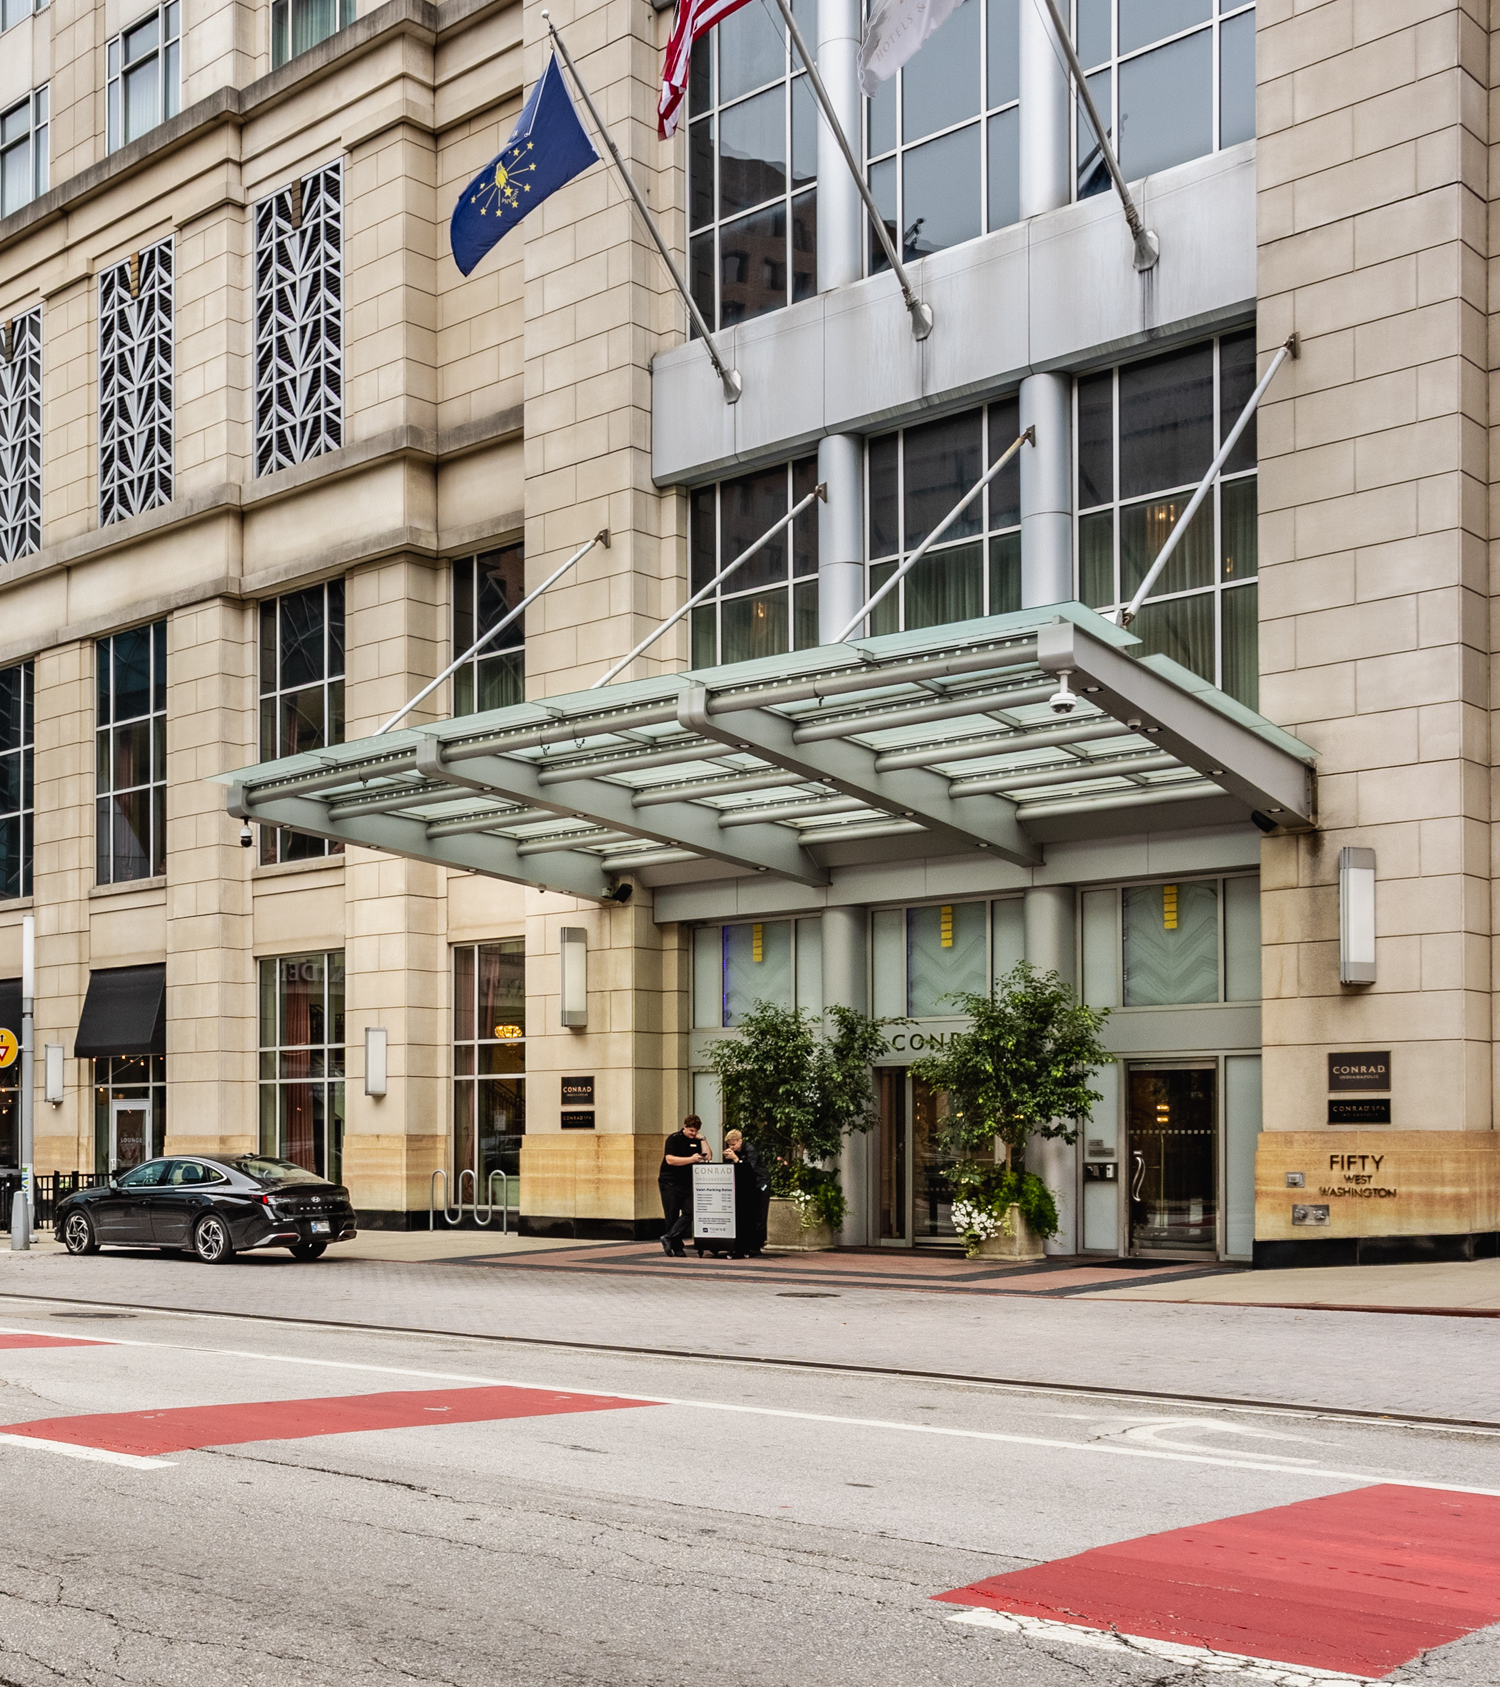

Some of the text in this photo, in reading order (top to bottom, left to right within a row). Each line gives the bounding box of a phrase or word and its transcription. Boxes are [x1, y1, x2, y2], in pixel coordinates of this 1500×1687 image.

[875, 13, 914, 61] HOTELS
[916, 2, 926, 13] &
[1332, 1065, 1385, 1074] CONRAD
[1329, 1154, 1384, 1172] FIFTY
[694, 1167, 733, 1175] CONRAD
[1343, 1174, 1373, 1185] WEST
[1319, 1187, 1397, 1198] WASHINGTON
